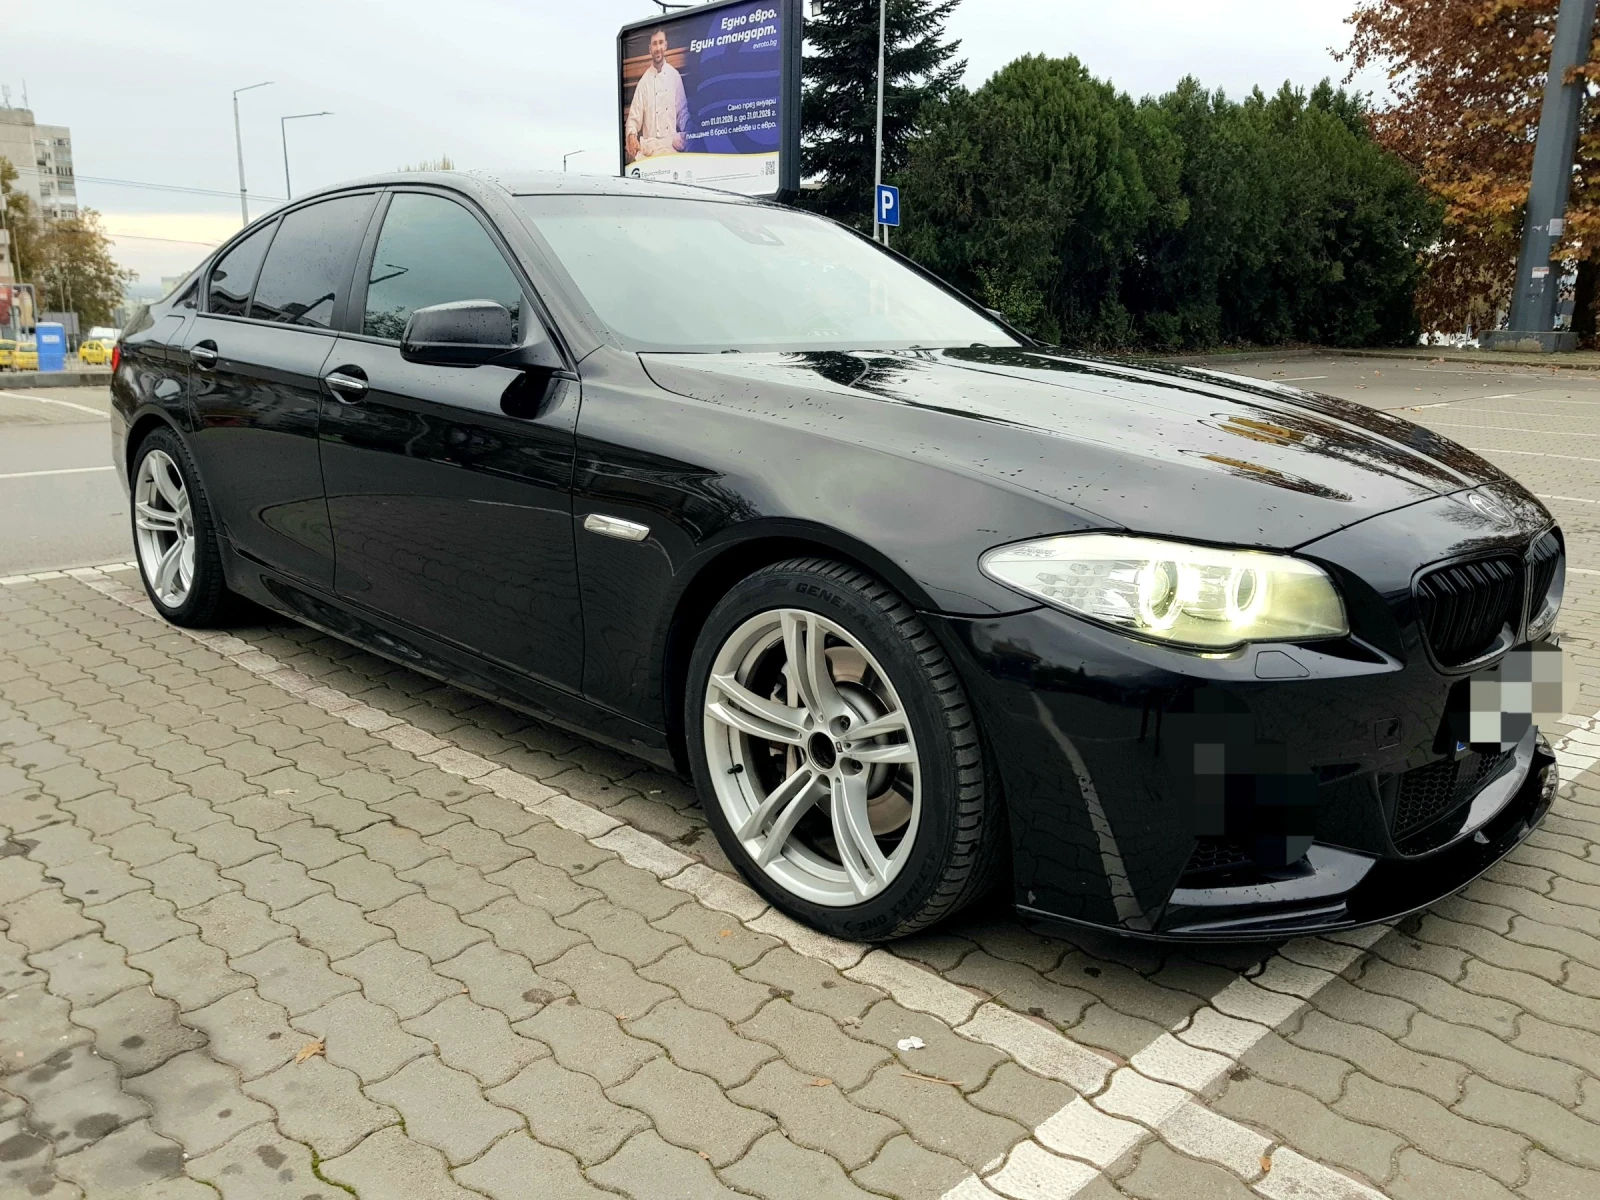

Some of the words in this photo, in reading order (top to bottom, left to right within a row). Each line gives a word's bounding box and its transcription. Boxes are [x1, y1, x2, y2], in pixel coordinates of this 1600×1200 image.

[721, 16, 746, 30] Едно
[748, 8, 777, 23] евро.
[690, 37, 714, 52] Един
[716, 25, 777, 45] стандарт.
[753, 39, 778, 49] evroto.bg
[743, 101, 756, 109] през
[756, 98, 777, 108] януари
[711, 114, 733, 125] 01.01.2026
[747, 108, 771, 120] 31.01.2026
[686, 131, 709, 140] плащаме
[710, 128, 714, 136] в
[715, 126, 728, 137] брой
[732, 124, 752, 133] левове
[881, 190, 894, 218] P
[856, 914, 888, 936] ONE
